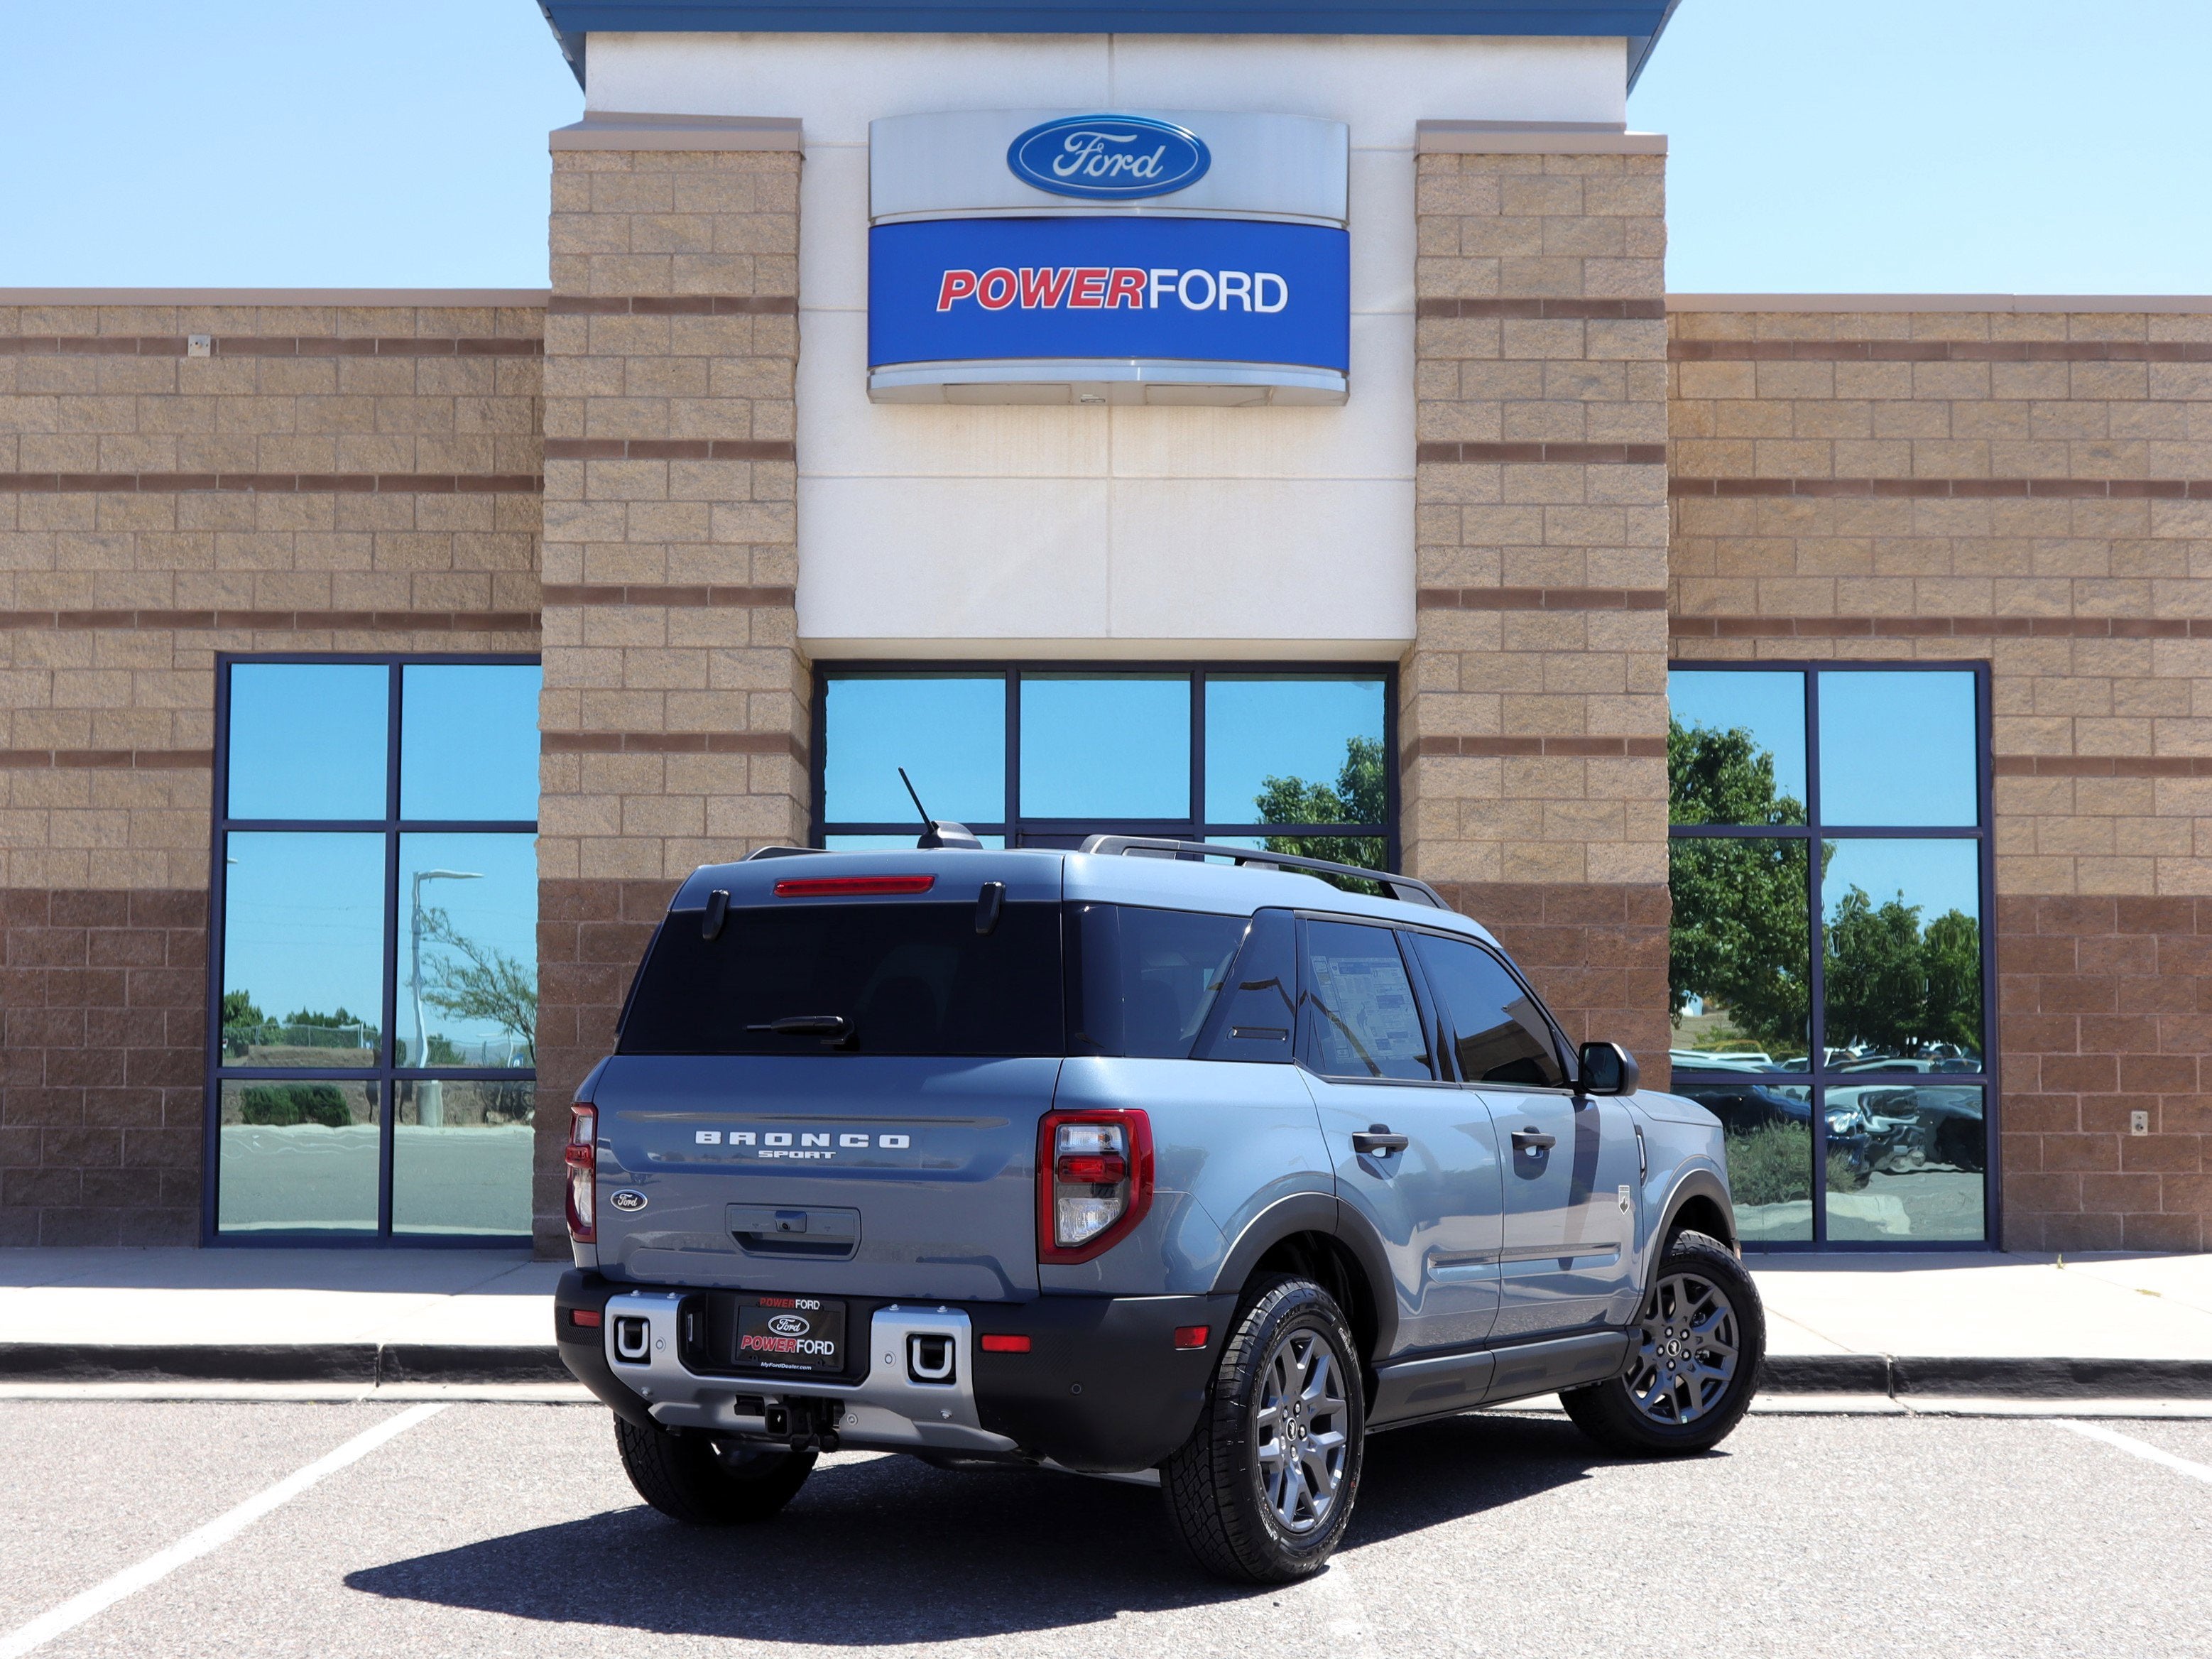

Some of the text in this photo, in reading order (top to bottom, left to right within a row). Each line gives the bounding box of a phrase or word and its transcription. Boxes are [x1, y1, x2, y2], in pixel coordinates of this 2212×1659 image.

[1052, 131, 1167, 178] Ford
[936, 266, 1289, 313] POWERFORD
[695, 1130, 910, 1149] BRONCO
[758, 1150, 837, 1159] SPORT
[617, 1193, 638, 1207] Ford
[760, 1298, 820, 1310] POWERFORD
[776, 1318, 801, 1332] Ford
[741, 1335, 834, 1355] POWERFORD
[761, 1361, 812, 1370] MyFordDealer.com
